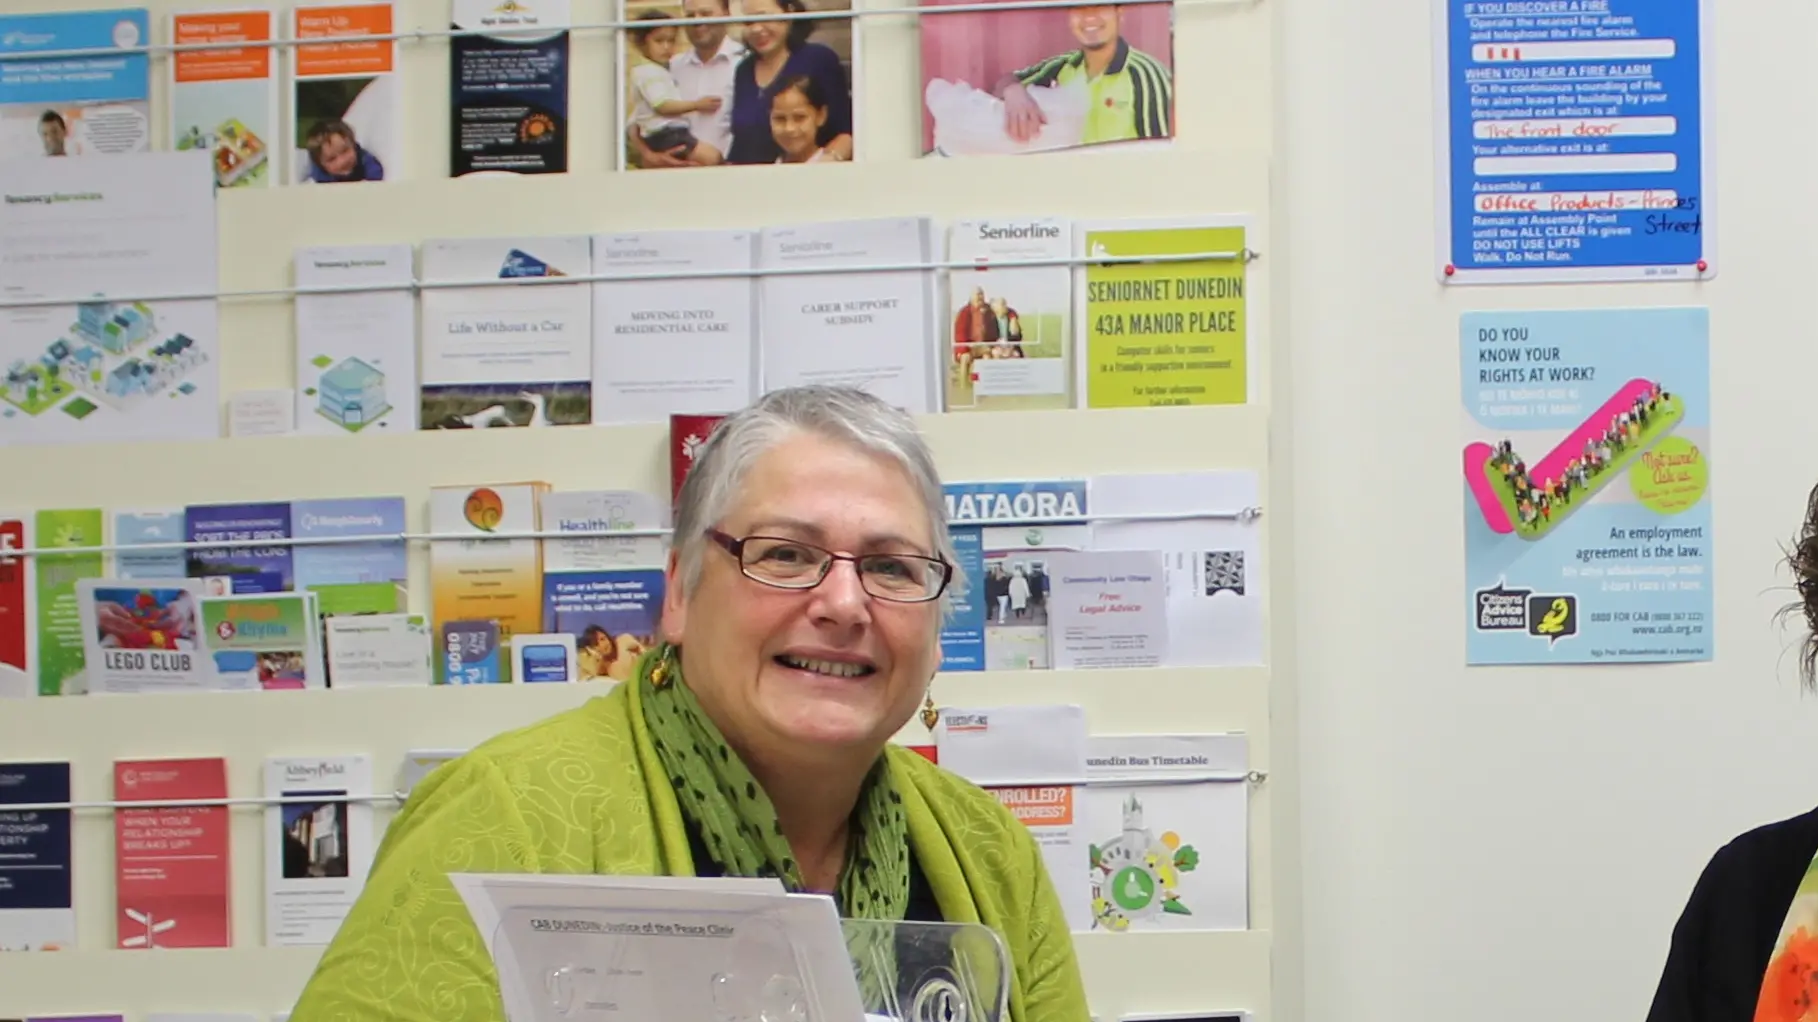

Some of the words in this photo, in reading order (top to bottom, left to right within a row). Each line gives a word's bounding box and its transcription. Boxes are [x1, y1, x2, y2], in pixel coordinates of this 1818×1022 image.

[1465, 4, 1473, 15] IF
[1479, 4, 1502, 15] YOU
[1507, 2, 1567, 14] DISCOVER
[1570, 2, 1578, 10] A
[1582, 0, 1606, 10] FIRE
[1469, 16, 1513, 29] Operate
[1516, 18, 1533, 26] the
[1537, 16, 1578, 26] nearest
[1581, 15, 1598, 25] fire
[1602, 16, 1633, 25] alarm
[1470, 28, 1492, 40] and
[1494, 30, 1548, 40] telephone
[1551, 29, 1568, 38] the
[1571, 28, 1593, 37] Fire
[1596, 27, 1639, 37] Service.
[1466, 69, 1501, 80] WHEN
[1505, 68, 1529, 79] YOU
[1533, 67, 1565, 78] HEAR
[1569, 67, 1576, 76] A
[1580, 66, 1605, 77] FIRE
[1610, 65, 1651, 76] ALARM
[1470, 82, 1487, 94] On
[1490, 82, 1508, 93] the
[1511, 81, 1572, 93] continuous
[1575, 81, 1628, 93] sounding
[1630, 80, 1641, 90] of
[1644, 81, 1661, 90] the
[1471, 96, 1489, 106] fire
[1492, 96, 1523, 106] alarm
[1526, 96, 1555, 105] leave
[1557, 96, 1575, 104] the
[1578, 92, 1624, 105] building
[1624, 92, 1639, 104] by
[1642, 94, 1667, 105] your
[1485, 126, 1512, 137] The
[1520, 125, 1561, 137] front
[1573, 122, 1618, 136] door
[1472, 181, 1527, 192] Assemble
[1481, 197, 1537, 210] Office
[1551, 195, 1624, 211] Products
[1473, 216, 1515, 226] Remain
[1518, 216, 1528, 226] at
[1530, 215, 1584, 226] Assembly
[1587, 214, 1617, 224] Point
[1645, 214, 1701, 234] Street
[980, 224, 1059, 239] Seniorline
[1473, 229, 1497, 238] until
[1500, 228, 1518, 237] the
[1520, 228, 1543, 237] ALL
[1545, 225, 1585, 237] CLEAR
[1588, 227, 1598, 236] is
[1601, 228, 1631, 238] given
[1473, 240, 1491, 250] DO
[1494, 240, 1518, 250] NOT
[1521, 239, 1545, 249] USE
[1548, 238, 1580, 249] LIFTS
[1473, 253, 1503, 262] Walk.
[1506, 252, 1522, 262] Do
[1524, 252, 1544, 261] Not
[1547, 251, 1571, 260] Run.
[1088, 280, 1171, 302] SENIORNET
[1176, 277, 1242, 300] DUNEDIN
[801, 303, 841, 314] CARER
[844, 299, 898, 310] SUPPORT
[631, 311, 680, 321] MOVING
[683, 310, 714, 319] INTO
[448, 322, 472, 334] Life
[476, 321, 527, 333] Without
[531, 324, 538, 332] a
[541, 320, 564, 331] Car
[615, 324, 694, 334] RESIDENTIAL
[697, 323, 728, 332] CARE
[1095, 315, 1124, 335] 43A
[1130, 313, 1184, 334] MANOR
[1190, 311, 1236, 332] PLACE
[1479, 328, 1497, 342] DO
[1502, 328, 1528, 341] YOU
[1480, 349, 1520, 362] KNOW
[1526, 347, 1560, 361] YOUR
[1480, 368, 1525, 383] RIGHTS
[1529, 368, 1544, 382] AT
[1549, 367, 1595, 381] WORK?
[558, 518, 637, 532] Healthline
[1610, 527, 1625, 539] An
[1629, 526, 1702, 542] employment
[1576, 548, 1638, 562] agreement
[1642, 548, 1651, 557] is
[1655, 545, 1674, 557] the
[1678, 544, 1702, 557] law.
[1480, 594, 1522, 605] Citizens
[1079, 605, 1106, 615] Legal
[1482, 605, 1523, 615] Advice
[1481, 615, 1523, 626] Bureau
[105, 652, 145, 670] LEGO
[151, 653, 191, 671] CLUB
[1087, 757, 1127, 766] unedin
[1130, 756, 1149, 766] Bus
[1152, 755, 1209, 766] Timetable
